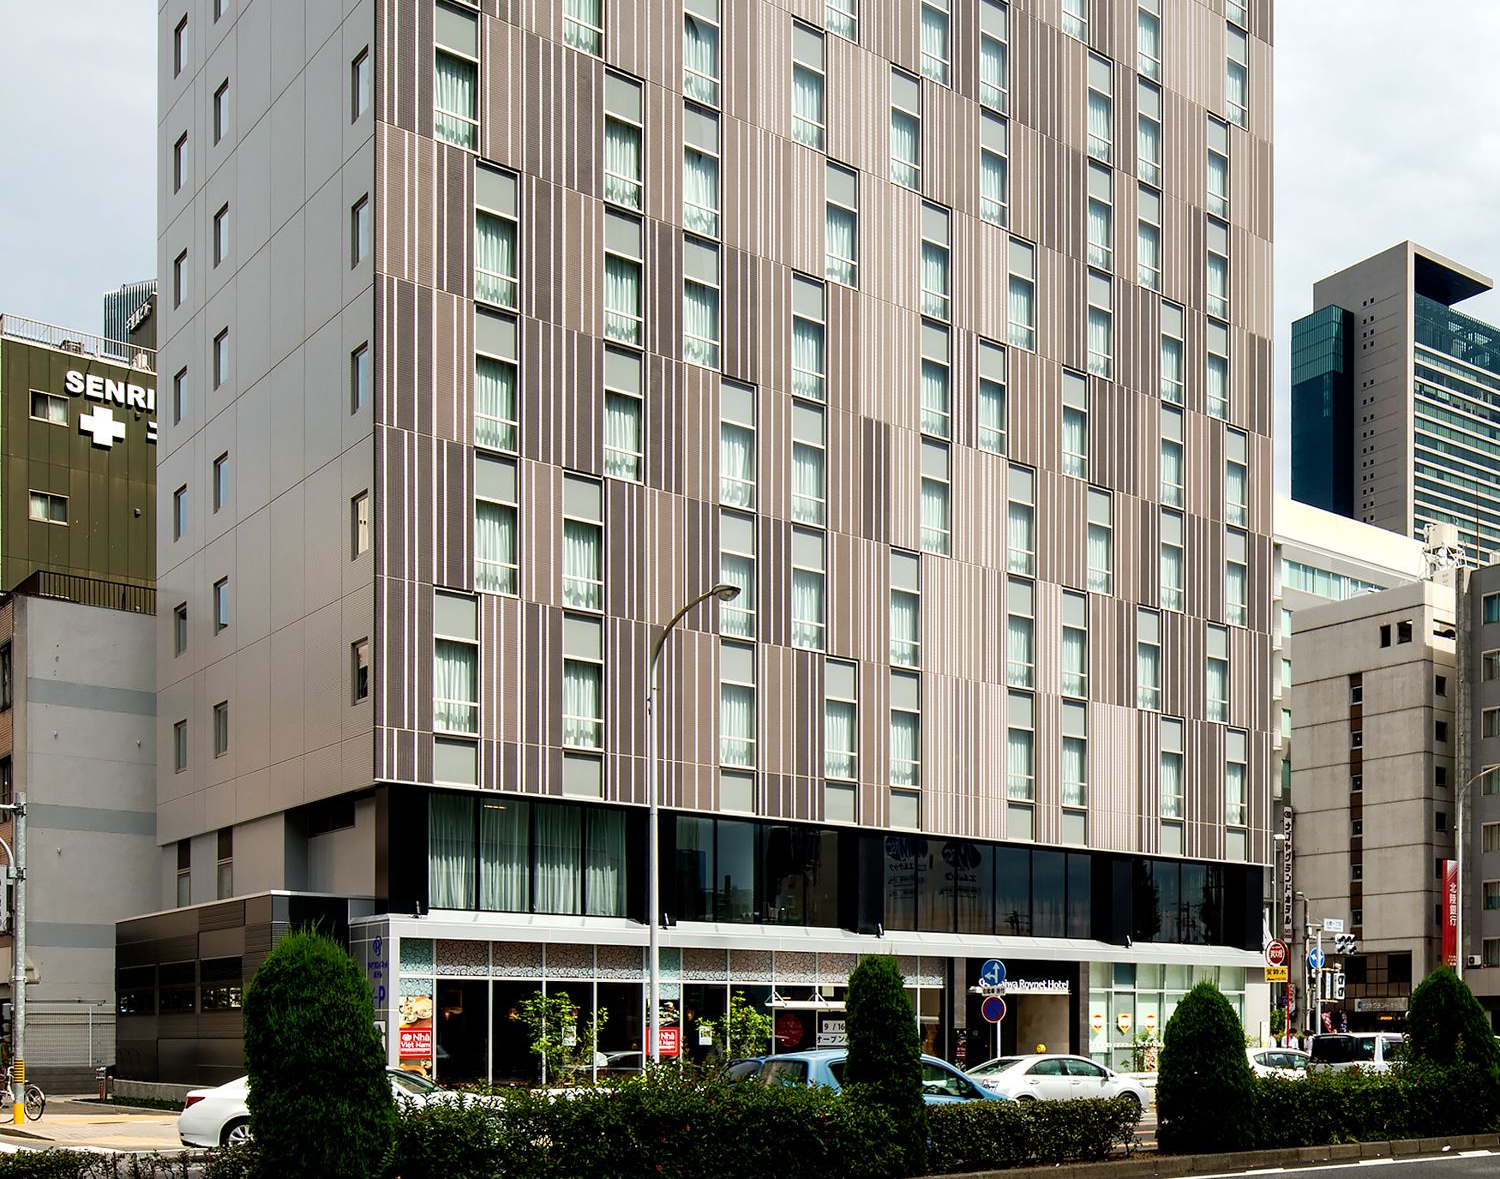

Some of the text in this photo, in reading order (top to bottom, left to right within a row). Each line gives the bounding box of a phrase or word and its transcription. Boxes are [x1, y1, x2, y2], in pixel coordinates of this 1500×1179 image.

[65, 370, 155, 410] SENRI
[1018, 979, 1047, 990] Roynet
[1048, 980, 1069, 990] Hotel
